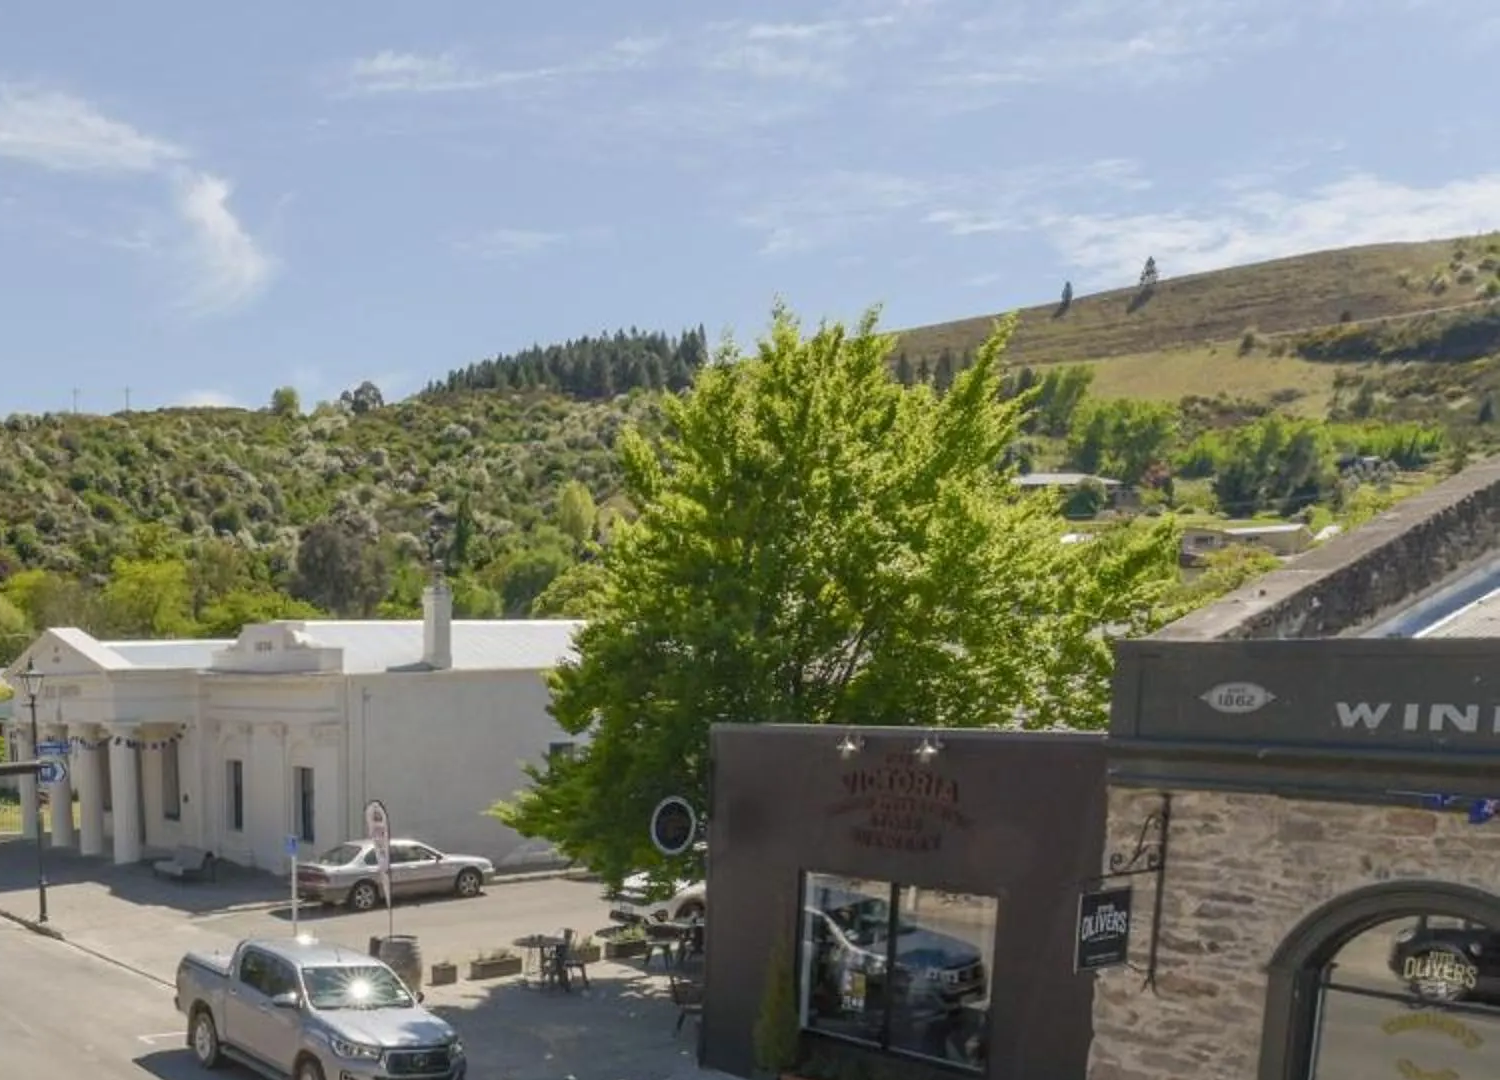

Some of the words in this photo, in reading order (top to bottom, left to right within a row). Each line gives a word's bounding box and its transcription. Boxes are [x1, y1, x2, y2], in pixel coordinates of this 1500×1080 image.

[1336, 701, 1500, 733] WIN
[1081, 911, 1128, 941] OLIVERS
[1403, 956, 1478, 989] OLIVERS
